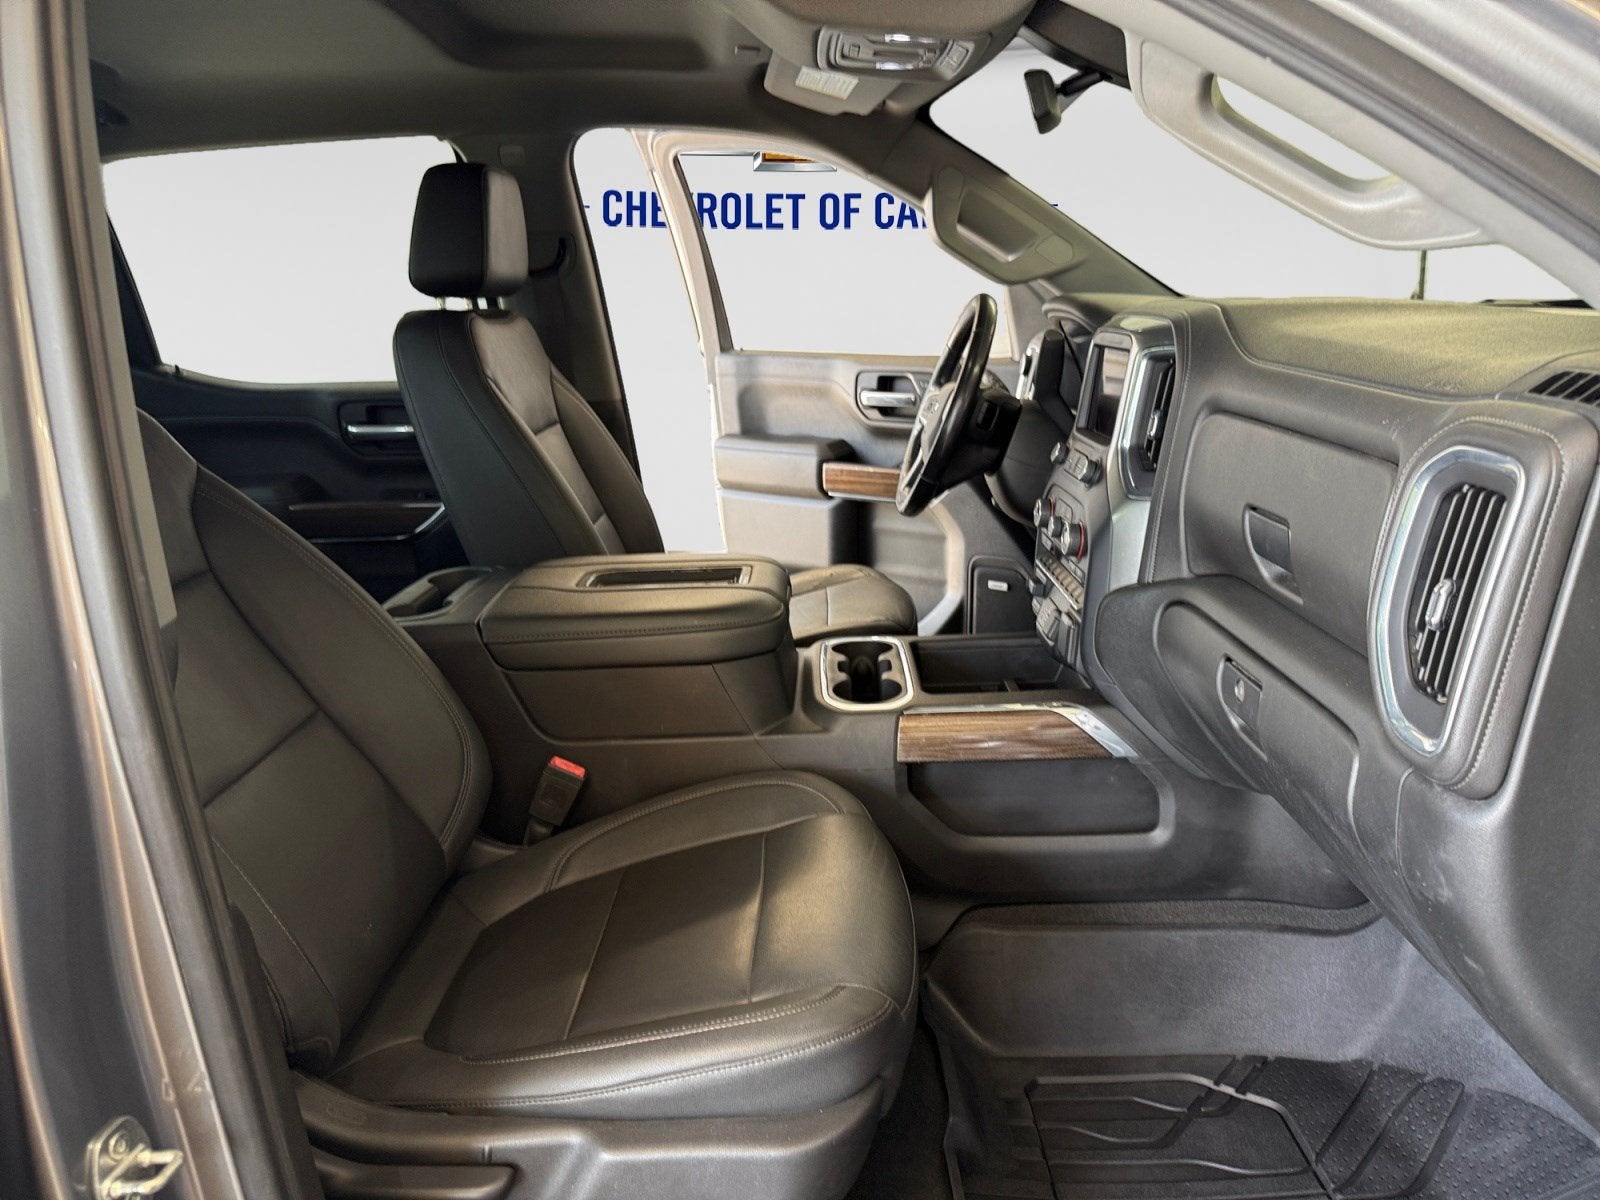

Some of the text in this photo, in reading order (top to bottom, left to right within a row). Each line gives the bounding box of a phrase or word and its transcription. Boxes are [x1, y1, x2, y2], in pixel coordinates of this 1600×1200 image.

[602, 189, 927, 231] CHEROLET OF CA
